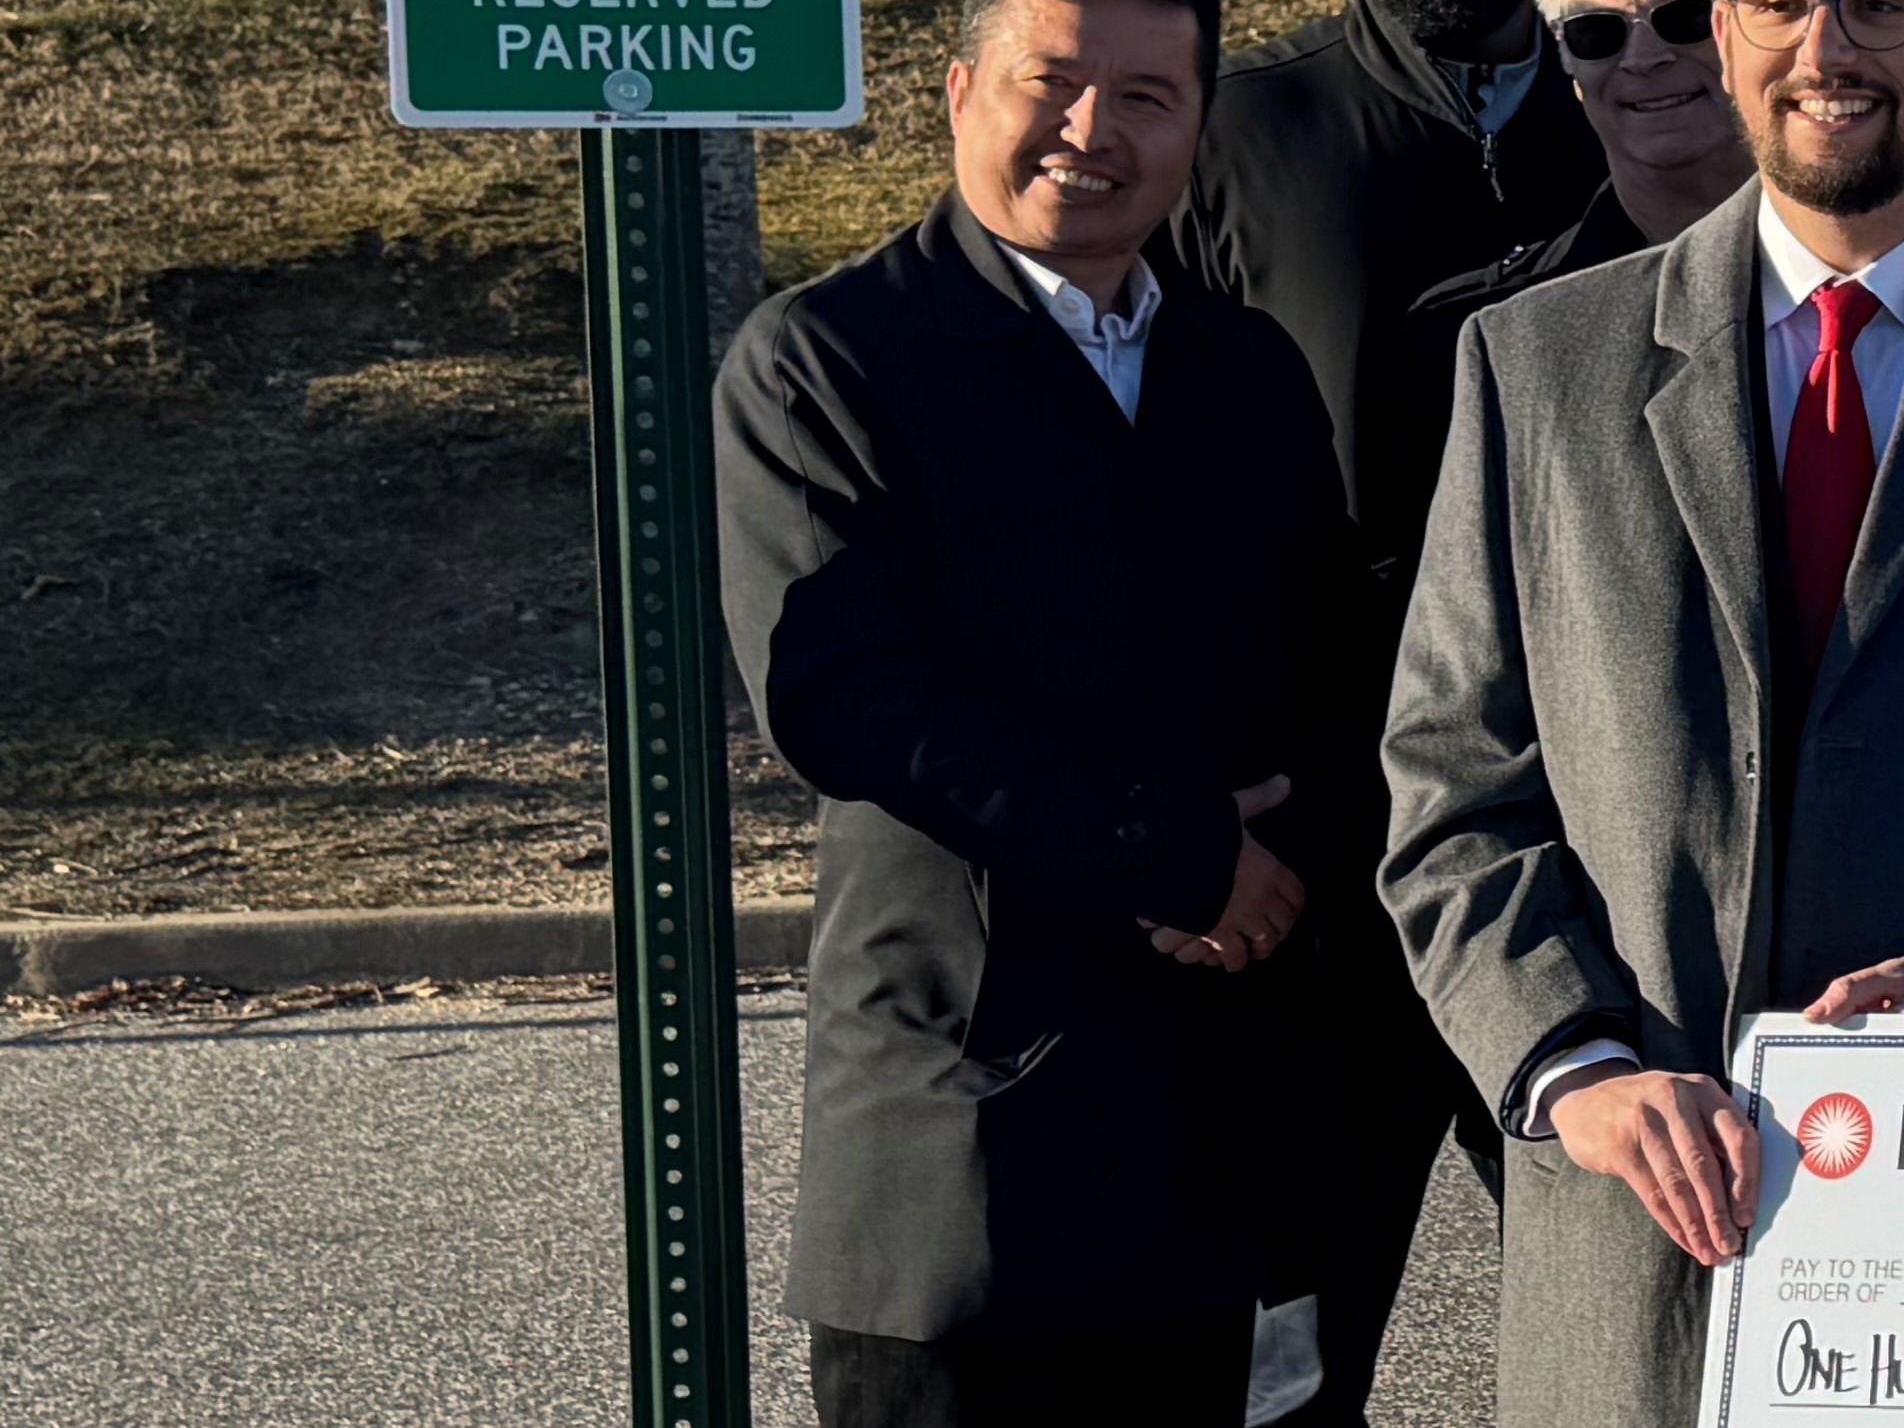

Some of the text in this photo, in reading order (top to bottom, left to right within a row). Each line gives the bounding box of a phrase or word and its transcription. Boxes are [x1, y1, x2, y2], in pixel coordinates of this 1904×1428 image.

[498, 24, 756, 71] PARKING
[1781, 1257, 1901, 1280] PAY TO THE
[1779, 1281, 1885, 1302] ORDER OF
[1777, 1318, 1859, 1397] ONE
